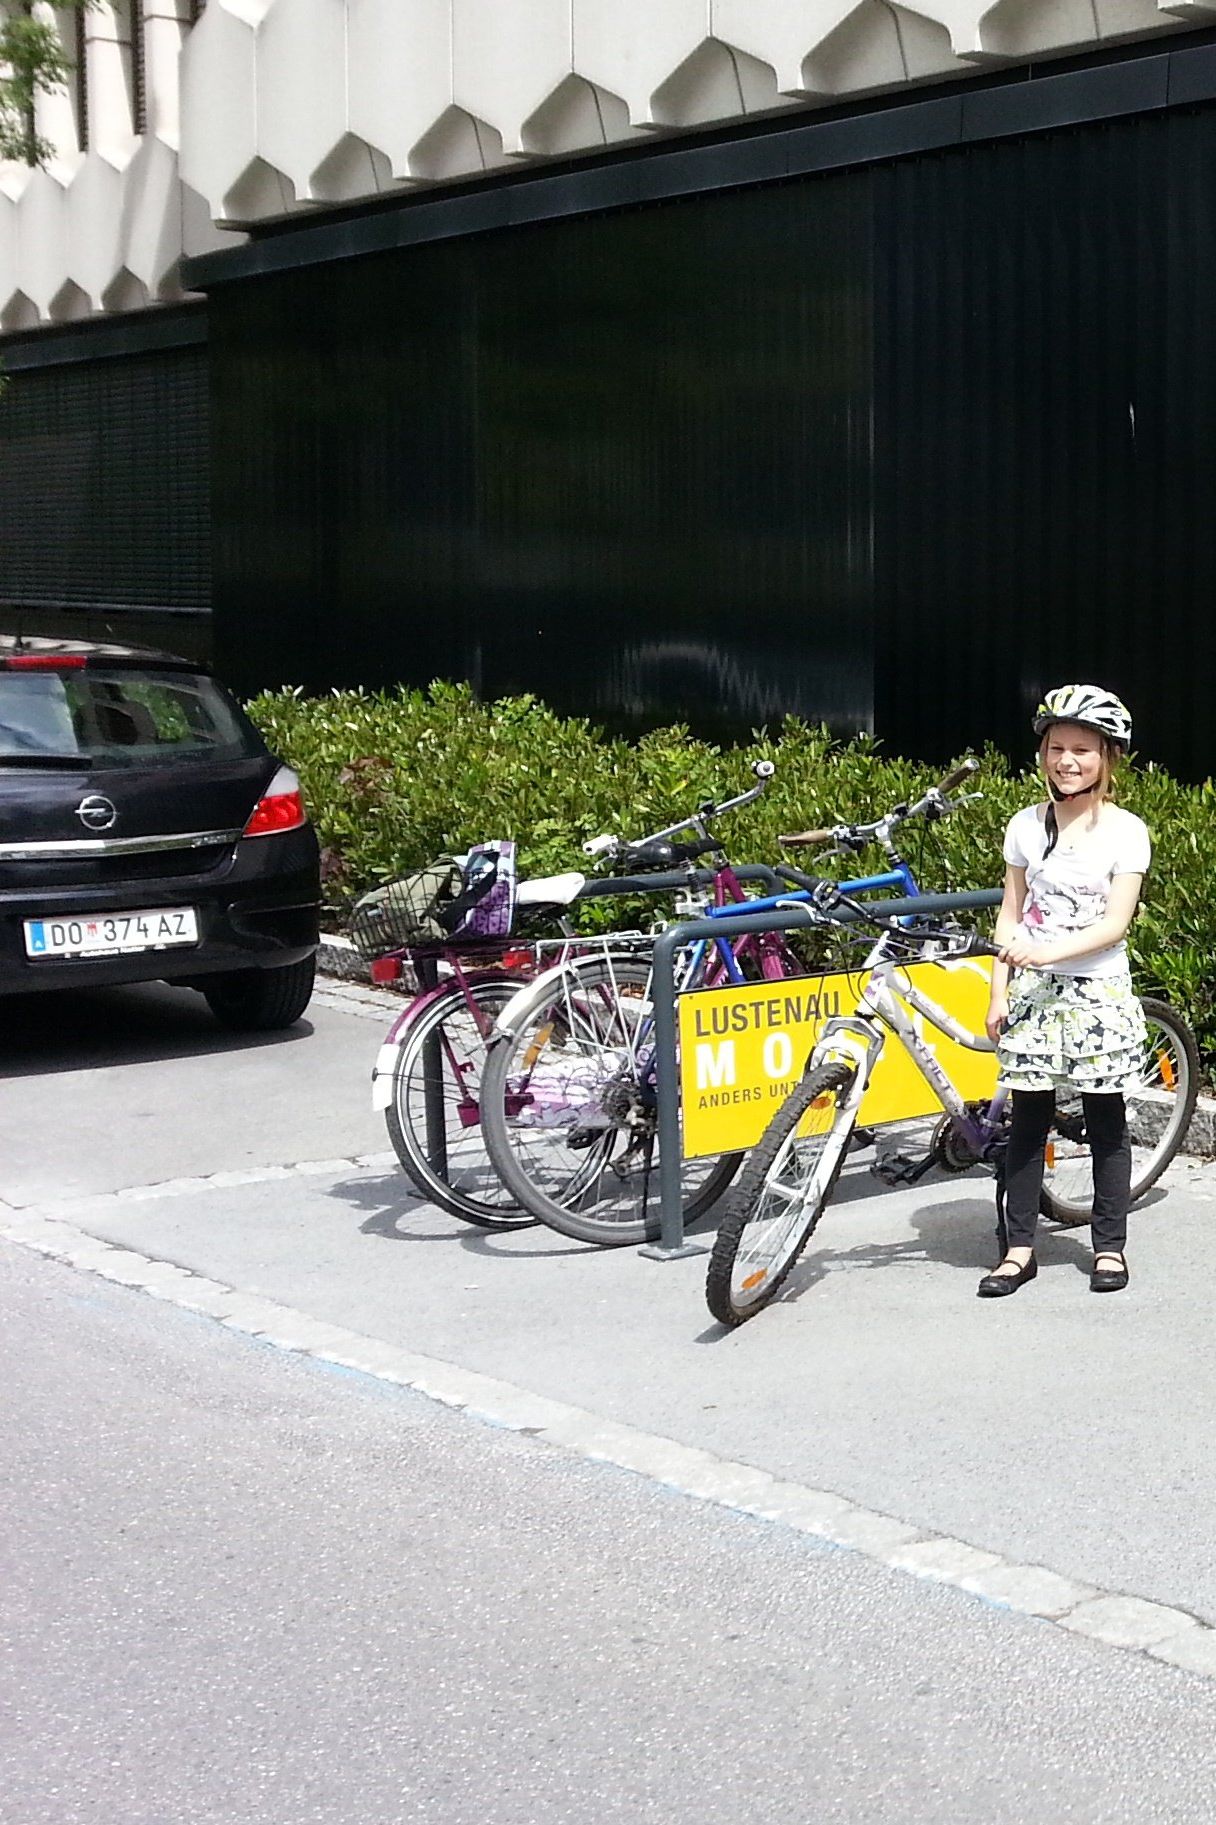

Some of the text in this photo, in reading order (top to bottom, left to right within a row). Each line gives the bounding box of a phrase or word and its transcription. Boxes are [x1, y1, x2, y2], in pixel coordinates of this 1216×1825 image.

[103, 917, 149, 942] 374
[157, 913, 187, 937] AZ
[694, 991, 840, 1037] LUSTENAU
[698, 1086, 763, 1110] ANDERS
